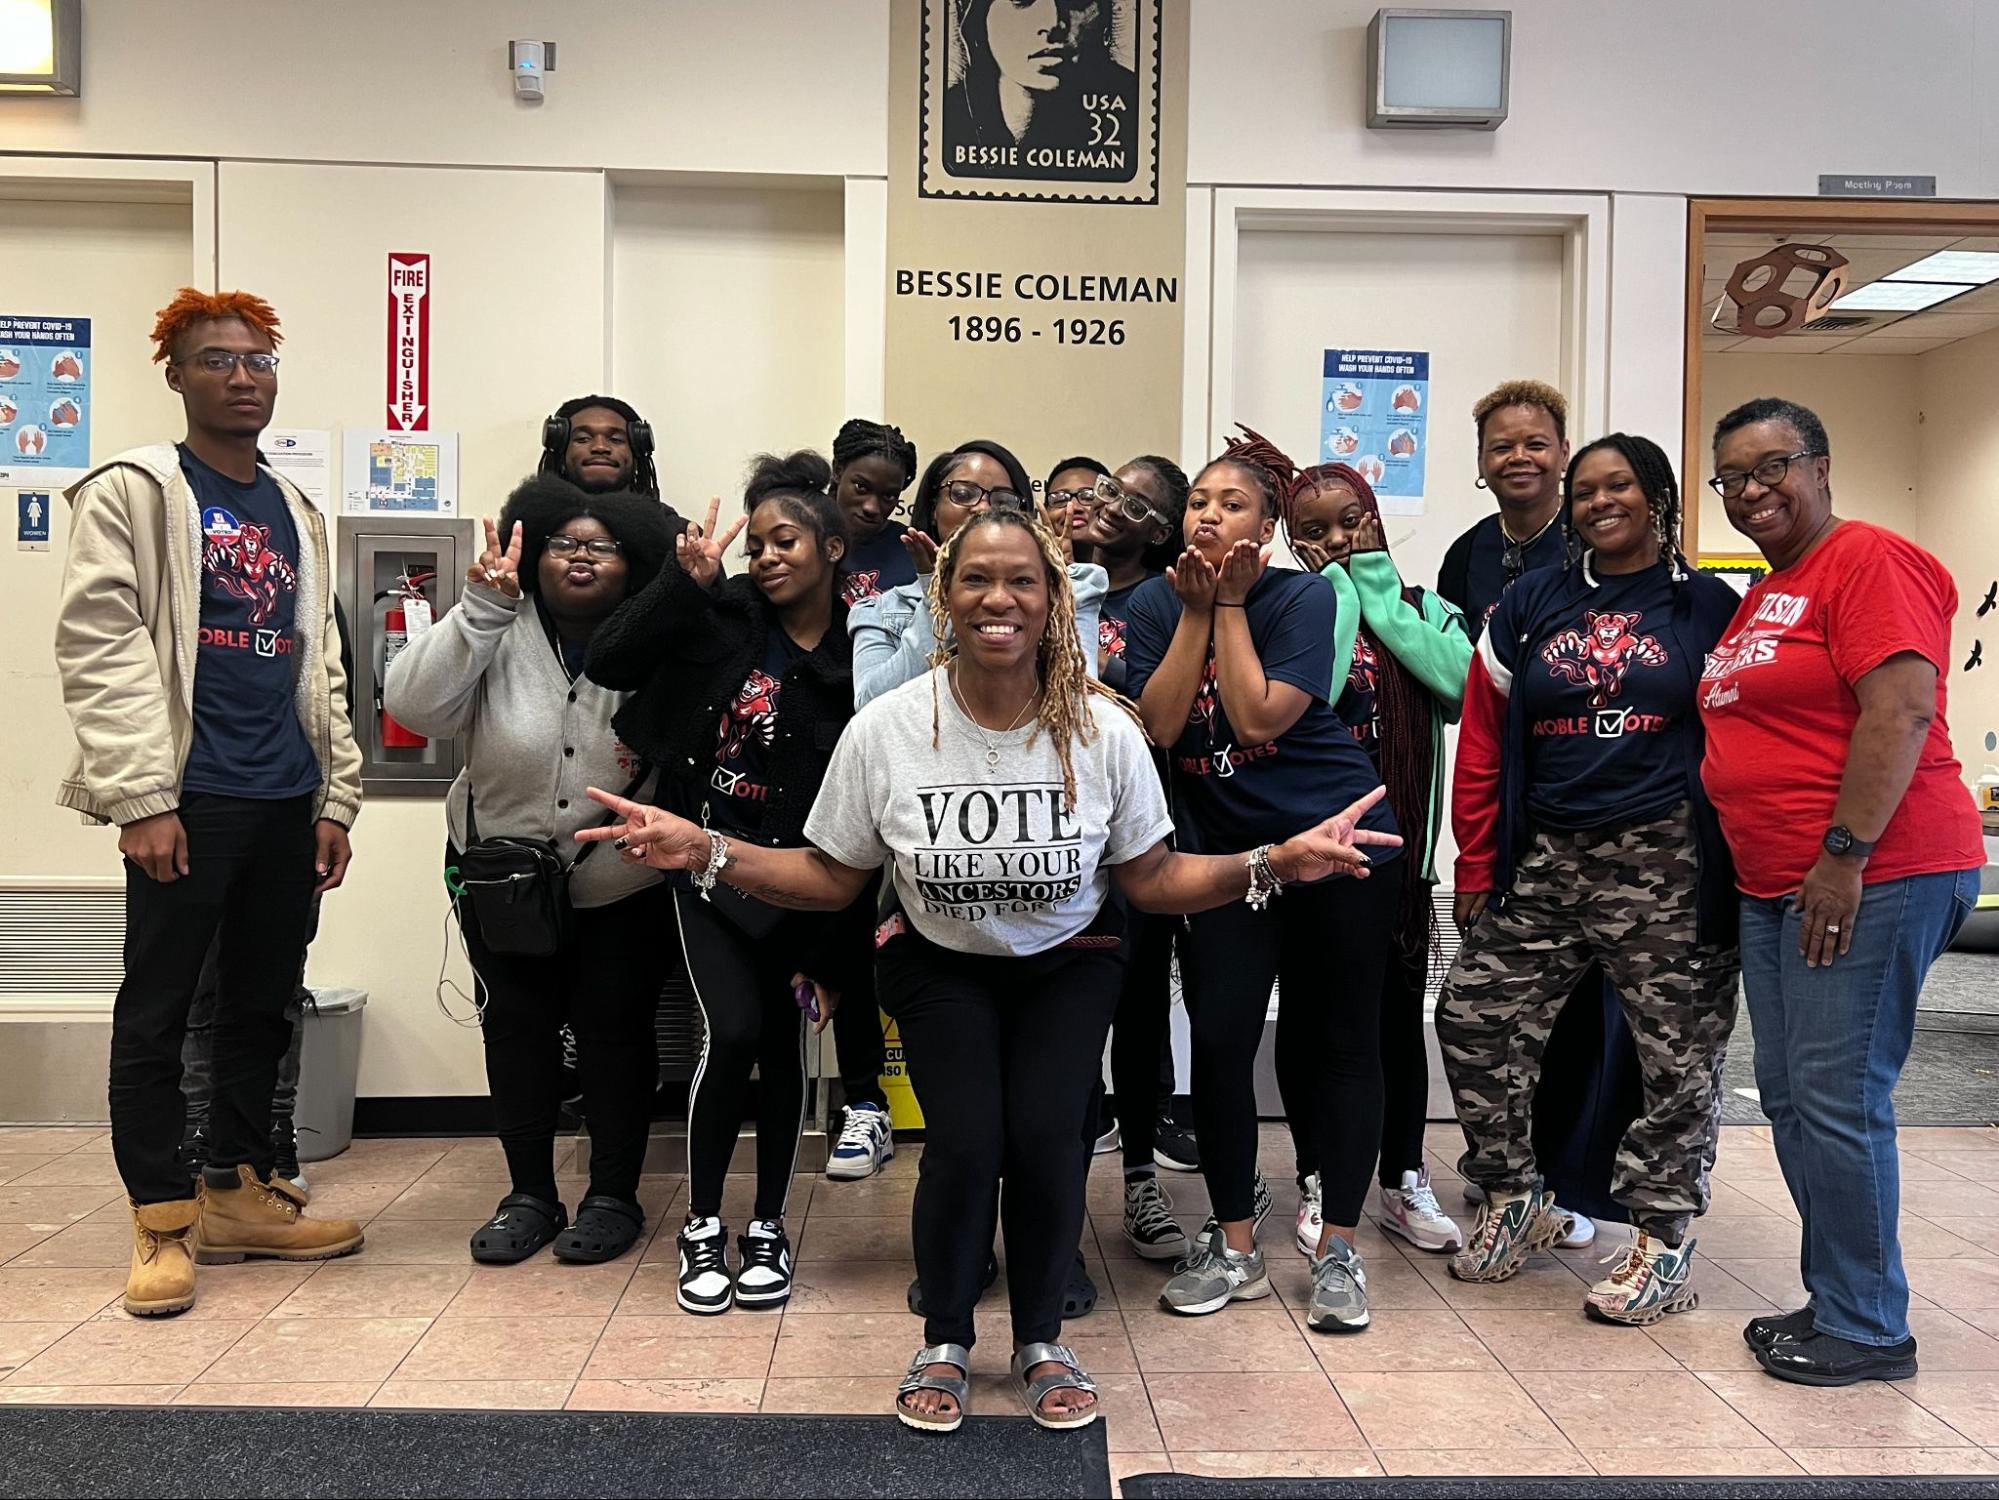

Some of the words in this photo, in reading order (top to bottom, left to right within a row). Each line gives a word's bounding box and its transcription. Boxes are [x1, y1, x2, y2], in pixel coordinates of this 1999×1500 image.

[1082, 94, 1127, 111] USA
[1088, 112, 1121, 146] 32
[955, 145, 1018, 166] BESSIE
[1026, 148, 1125, 169] COLEMAN
[1845, 179, 1882, 191] Meeting
[394, 269, 424, 287] FIRE
[896, 269, 1002, 299] BESSIE
[1014, 273, 1178, 303] COLEMAN
[13, 321, 41, 330] PREVENT
[14, 331, 31, 339] YOUR
[54, 332, 75, 341] OFTEN
[948, 315, 1022, 343] 1896
[1052, 318, 1126, 346] 1926
[401, 293, 415, 423] EXTINGUISHER
[1338, 364, 1357, 372] WASH
[1341, 354, 1357, 362] HELP
[198, 627, 250, 648] OBLE
[1702, 681, 1740, 709] Alumni
[1532, 717, 1588, 736] NOBLE
[917, 790, 1082, 845] VOTE
[914, 853, 985, 878] LIKE
[995, 848, 1081, 877] YOUR
[921, 878, 1080, 901] ANCESTORS
[924, 900, 987, 922] DIED
